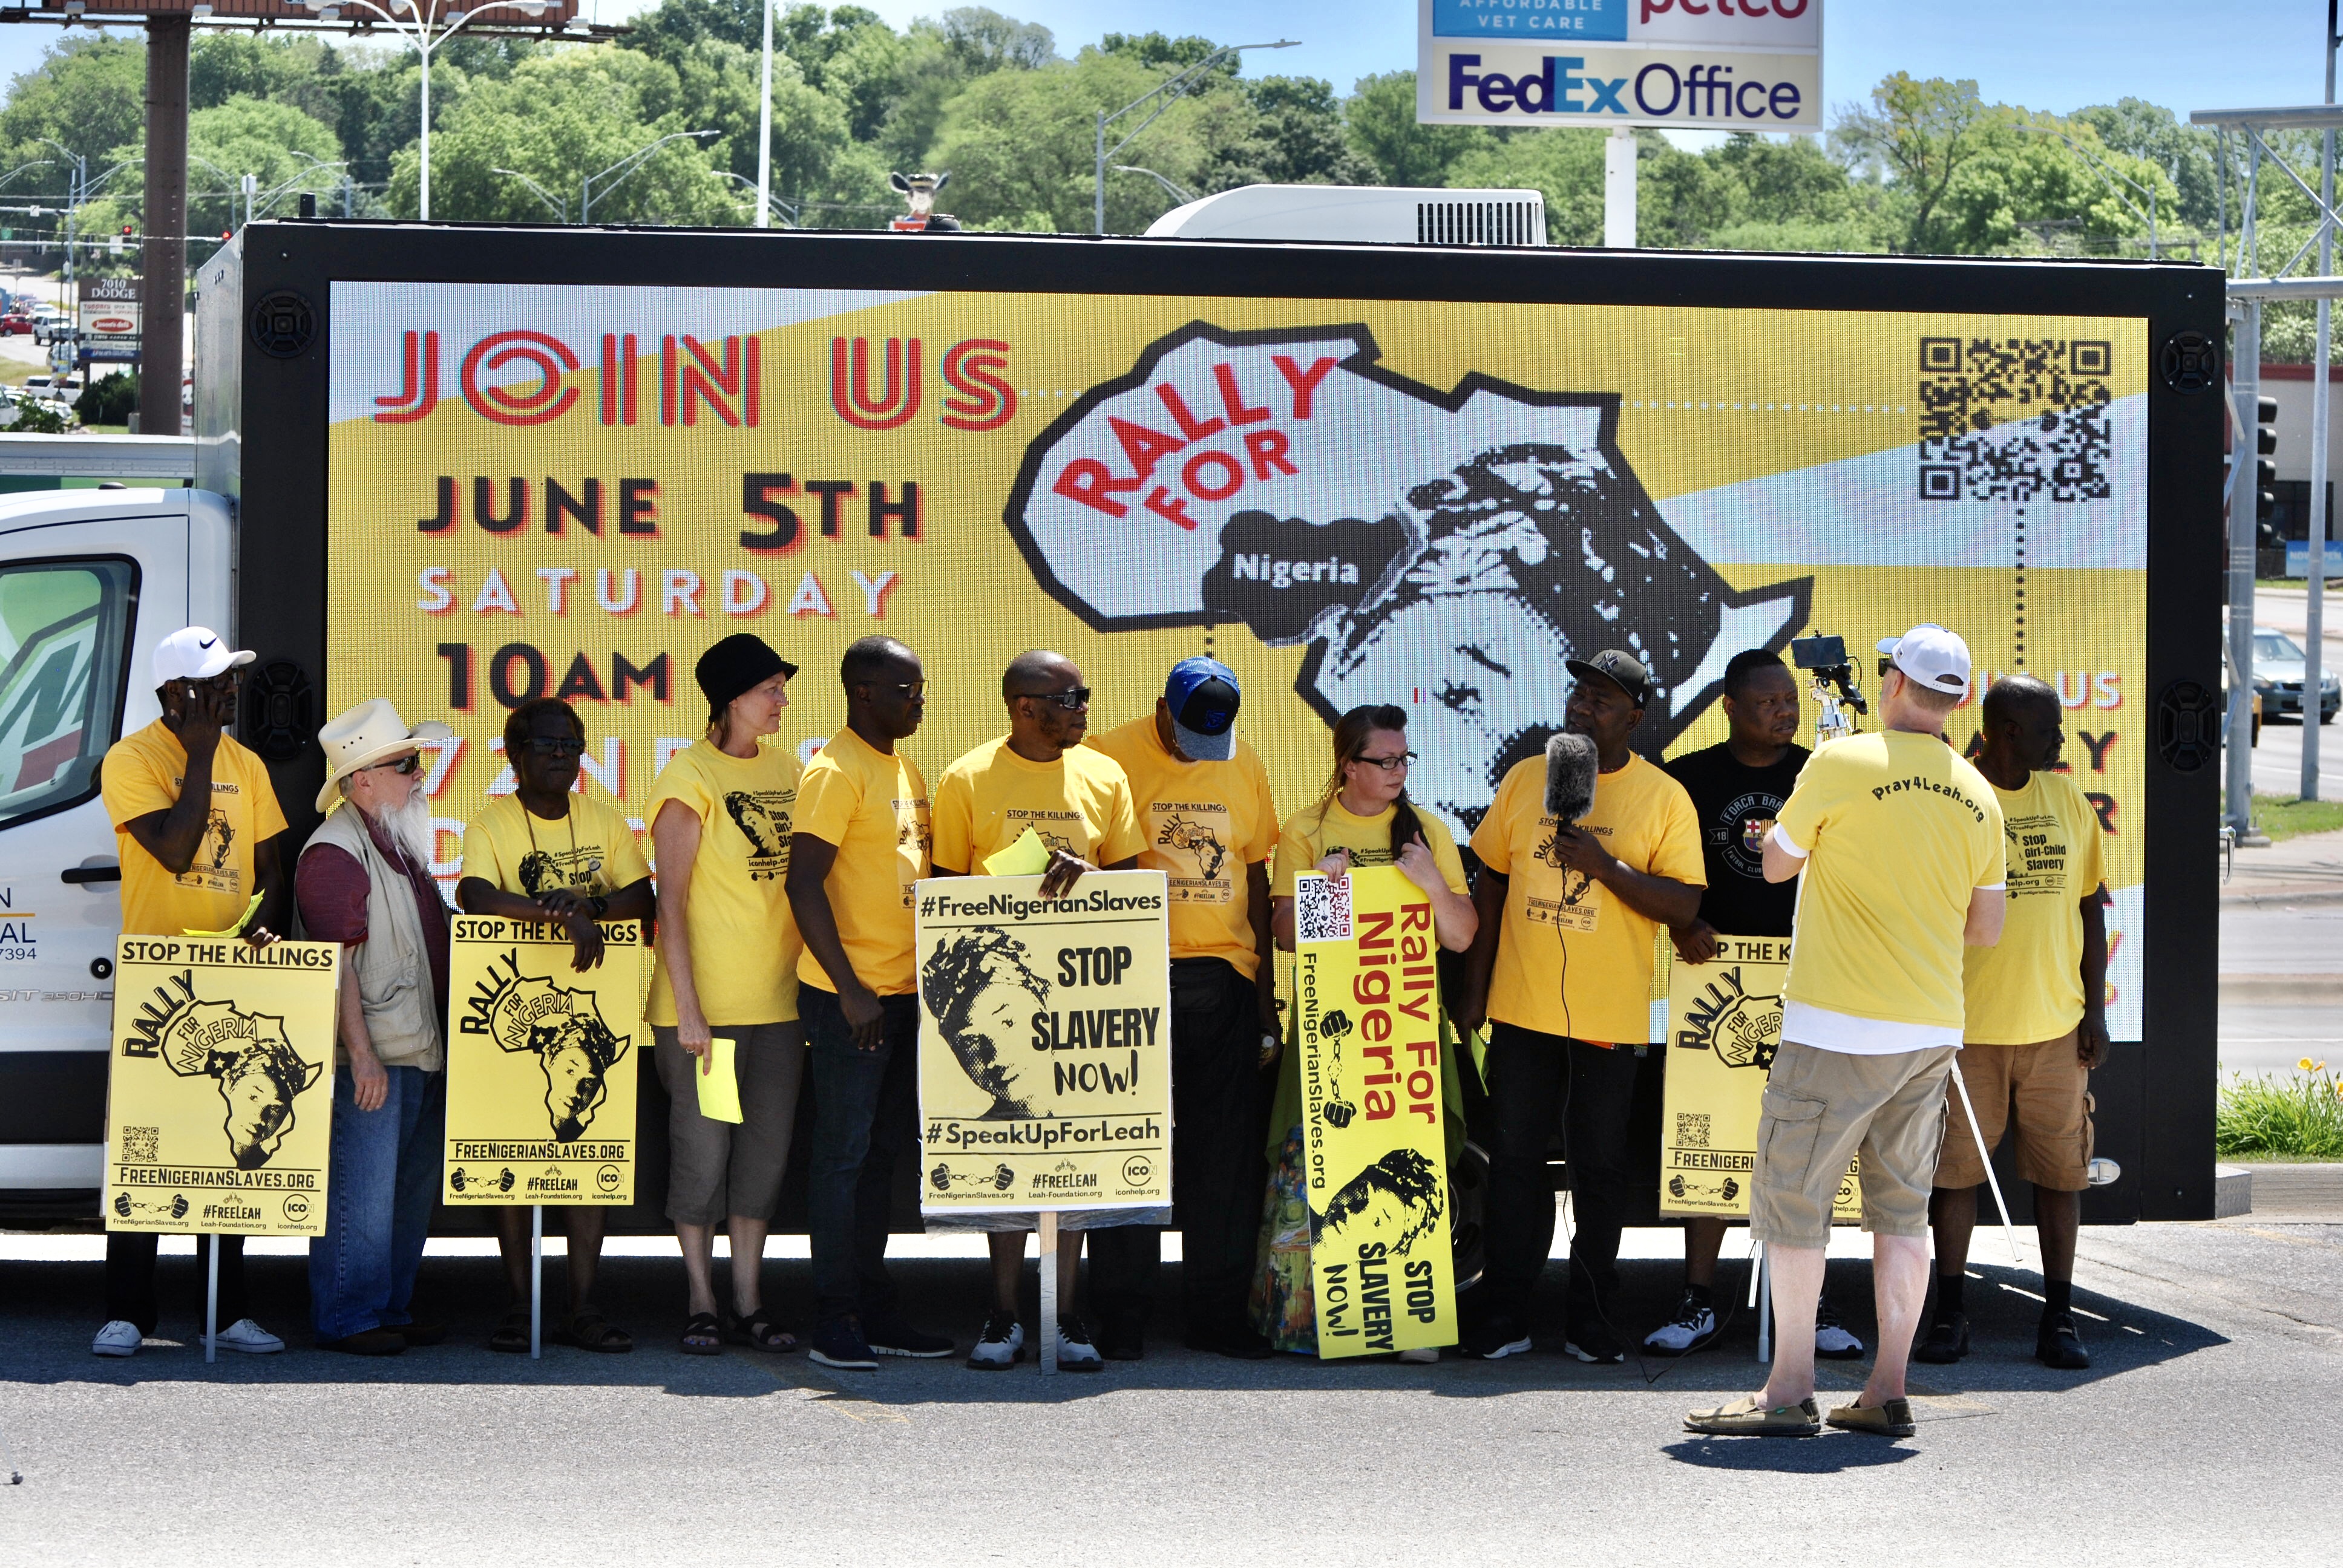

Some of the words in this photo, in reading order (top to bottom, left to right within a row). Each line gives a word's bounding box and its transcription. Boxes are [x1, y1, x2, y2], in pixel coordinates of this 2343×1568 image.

[1478, 15, 1516, 28] VET
[1529, 16, 1585, 30] CARE
[1448, 54, 1628, 114] FedEx
[1634, 62, 1801, 119] Office
[91, 288, 136, 299] DODGE
[101, 279, 126, 288] 7010
[372, 330, 761, 428] JOIN
[830, 336, 1018, 431] US
[1052, 354, 1339, 518] RALLY
[1143, 429, 1300, 531] FOR
[417, 475, 665, 538] JUNE
[739, 472, 924, 555] 5TH
[1232, 554, 1360, 587] Nigeria
[418, 566, 901, 618] SATURDAY
[437, 642, 674, 713] 10AM
[2056, 670, 2124, 710] US
[212, 783, 239, 792] ILLINGS
[1871, 776, 1985, 824] Pray4Leah.org
[768, 809, 790, 822] Stop
[1761, 795, 1784, 811] BAR
[1158, 813, 1182, 844] RALLY
[1717, 832, 1726, 840] 18
[2022, 834, 2046, 846] Stop
[748, 857, 789, 867] iconhelp.or
[1728, 851, 1744, 869] FUTBOL
[2025, 844, 2066, 858] Girl-Child
[2027, 858, 2064, 871] Slavery
[2005, 879, 2040, 887] help.org
[920, 890, 1162, 921] #FreeNigerianSlaves
[455, 920, 506, 939] STOP
[510, 921, 545, 940] THE
[550, 923, 638, 942] KNGS
[122, 941, 180, 961] STOP
[186, 944, 225, 963] THE
[232, 947, 333, 967] KILLINGS
[1398, 903, 1435, 1022] Rally
[1734, 942, 1772, 960] THE
[1057, 946, 1132, 987] STOP
[459, 947, 521, 1035] RALLY
[503, 993, 524, 1017] FOR
[122, 969, 197, 1059] RALLY
[503, 993, 574, 1047] NIGERIA
[1353, 912, 1402, 1121] Nigeria
[1676, 966, 1745, 1050] RALLY
[1726, 1010, 1749, 1034] FOR
[177, 1016, 200, 1040] FOR
[1031, 1007, 1161, 1051] SLAVERY
[1726, 1012, 1783, 1063] NIGER
[176, 1018, 258, 1073] NIGERIA
[1054, 1050, 1138, 1096] NOW!
[1303, 953, 1326, 1189] FreeNigerianSlaves.org
[1406, 1040, 1437, 1124] For
[926, 1118, 1161, 1149] #SpeakUpForLeah
[449, 1192, 516, 1201] FreeNigerianSlaves.org
[525, 1192, 583, 1201] Leah-Foundation.org
[592, 1192, 628, 1201] iconhelp.org
[928, 1191, 1015, 1200] FreeNigerianSlaves.org
[1028, 1190, 1103, 1199] Leah-Foundation.org
[1115, 1187, 1161, 1196] iconhelp.org
[1668, 1197, 1739, 1208] FreeNigerianSlaves.org
[113, 1218, 189, 1227] FreeNigerianSlaves.org
[200, 1221, 267, 1230] Leah-Foundation.org
[277, 1223, 318, 1232] iconhelp.org
[1323, 1263, 1359, 1337] NOW!
[1358, 1241, 1395, 1350] SLAVERY
[1404, 1260, 1436, 1324] STOP
